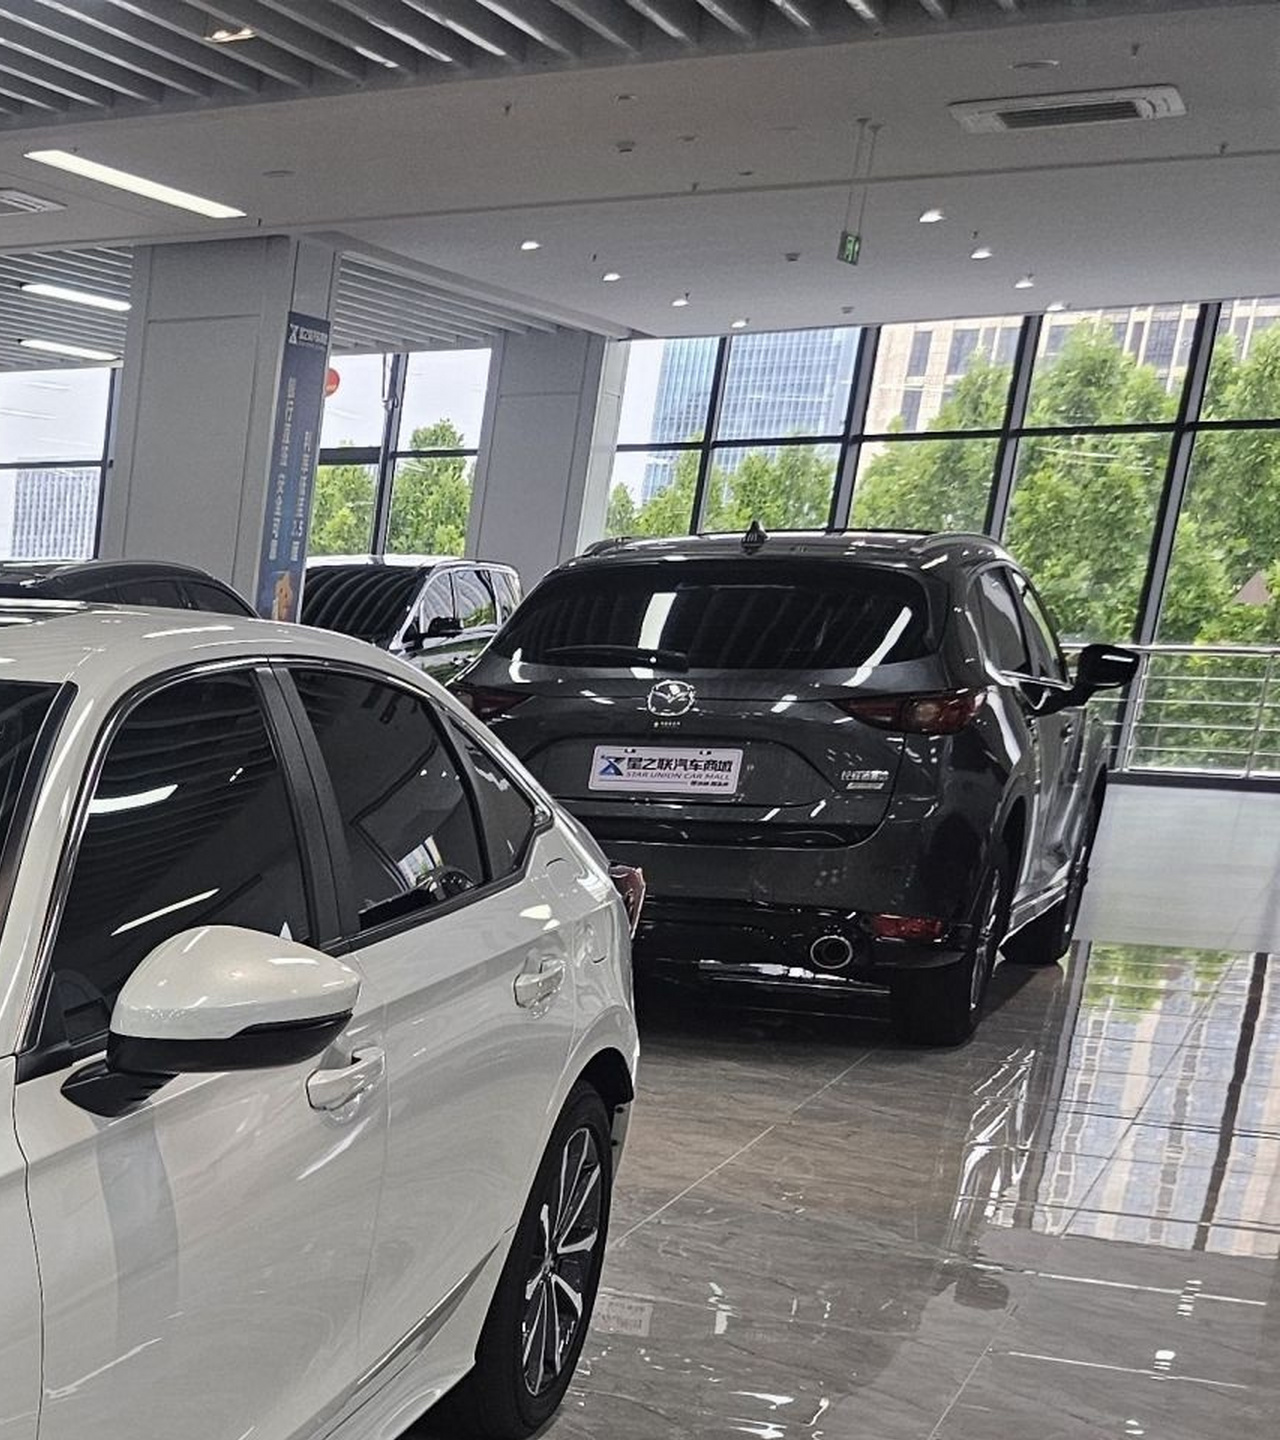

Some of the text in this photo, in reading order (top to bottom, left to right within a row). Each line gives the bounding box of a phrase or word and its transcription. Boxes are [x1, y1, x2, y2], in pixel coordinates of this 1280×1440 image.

[626, 757, 733, 772] 星之联汽车商城
